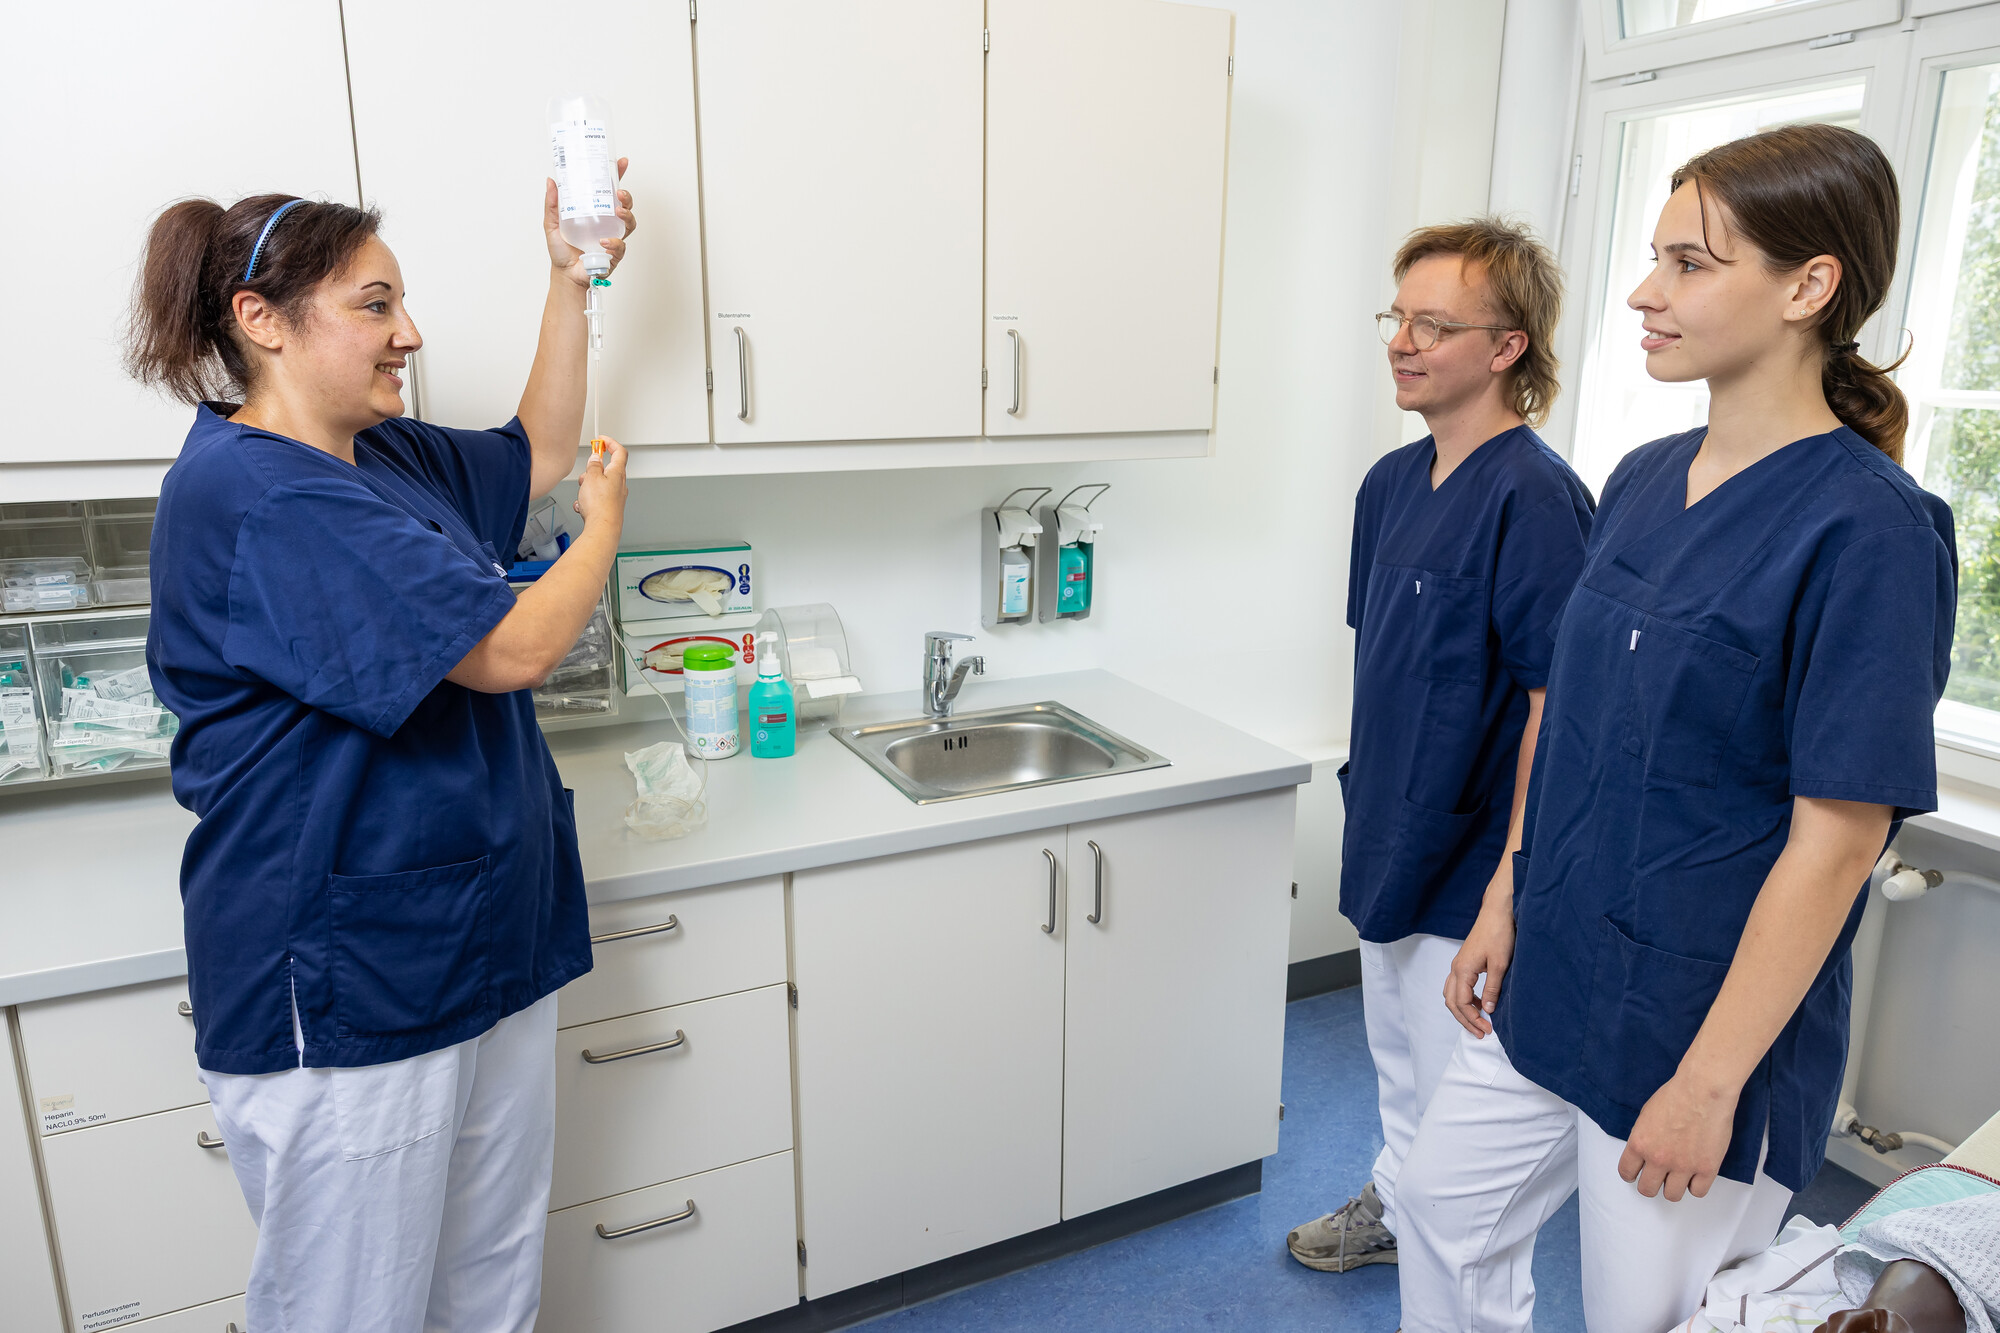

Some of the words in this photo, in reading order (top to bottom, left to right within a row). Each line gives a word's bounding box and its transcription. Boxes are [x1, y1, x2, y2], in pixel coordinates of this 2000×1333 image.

[44, 1110, 74, 1121] Heparin
[88, 1113, 107, 1122] 50ml
[82, 1301, 141, 1320] Perfusorsysteme
[83, 1312, 141, 1330] Perfusorspritzen
